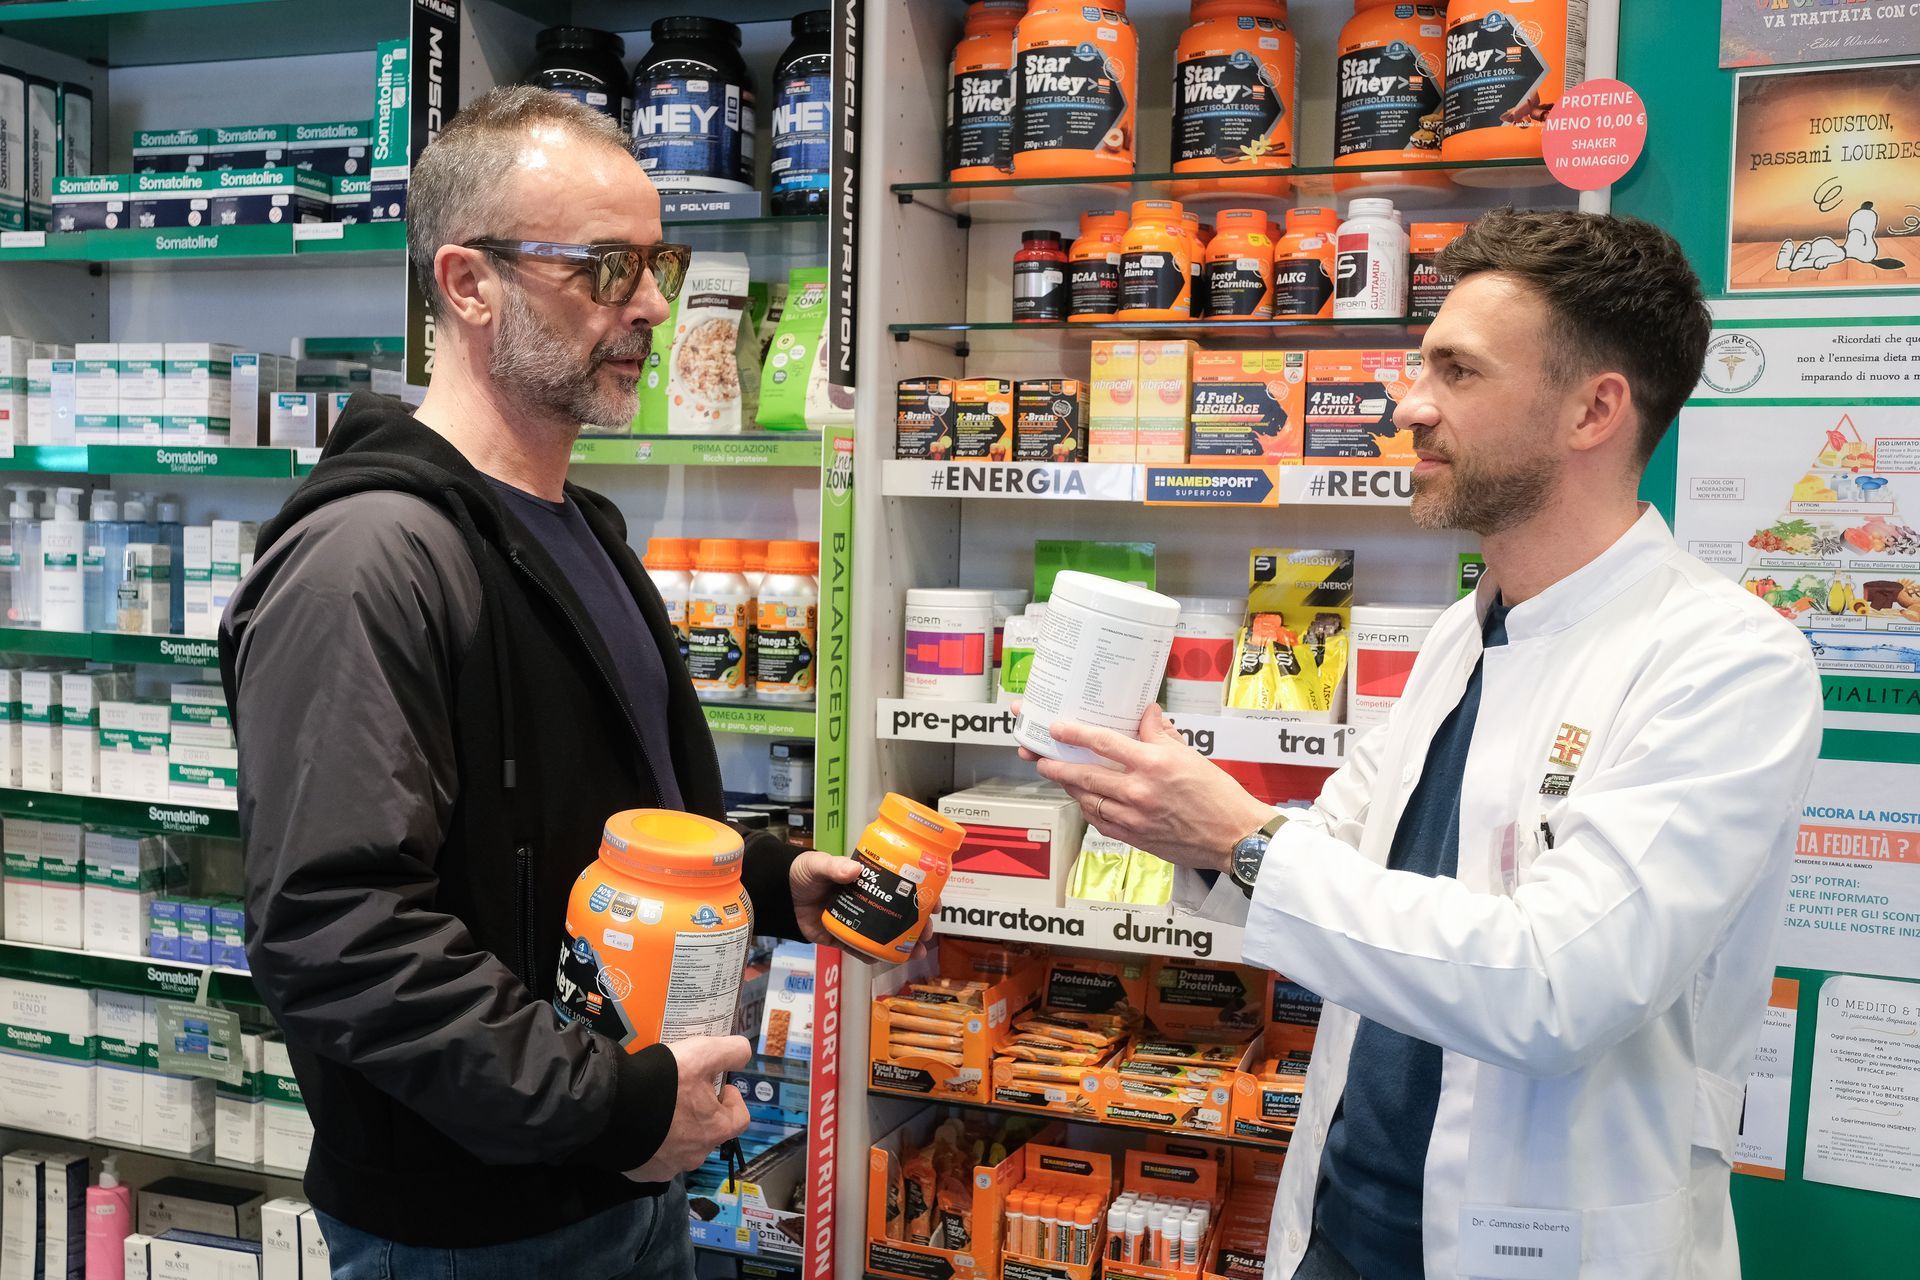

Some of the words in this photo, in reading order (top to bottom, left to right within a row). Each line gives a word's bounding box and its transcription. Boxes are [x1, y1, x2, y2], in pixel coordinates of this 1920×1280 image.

[1763, 15, 1786, 28] VA
[1791, 8, 1872, 26] TRATTATA
[1876, 4, 1905, 19] CON
[1447, 31, 1478, 57] Star
[1025, 54, 1071, 75] Star
[1341, 56, 1381, 80] Star
[1446, 49, 1495, 77] Whey
[1183, 65, 1226, 86] Star
[1493, 67, 1515, 76] 100%
[961, 77, 1003, 97] Star
[1025, 73, 1087, 96] Whey
[1342, 75, 1398, 98] Whey
[1184, 82, 1242, 104] Whey
[1396, 95, 1418, 103] 100%
[1561, 91, 1633, 109] PROTEINE
[374, 54, 395, 161] Somatoline
[962, 94, 1016, 116] Whey
[1240, 103, 1260, 111] 100%
[633, 103, 719, 136] WHEY
[1546, 114, 1591, 132] MENO
[1595, 113, 1633, 130] 10,00
[1635, 112, 1645, 126] €
[1809, 113, 1894, 136] HOUSTON,
[140, 131, 199, 147] Somatoline
[216, 127, 278, 143] Somatoline
[296, 125, 359, 140] Somatoline
[1571, 137, 1617, 150] SHAKER
[1555, 155, 1568, 168] IN
[1572, 153, 1630, 168] OMAGGIO
[1750, 145, 1831, 171] passami
[59, 178, 120, 194] Somatoline
[138, 175, 203, 191] Somatoline
[219, 171, 284, 187] Somatoline
[664, 202, 676, 213] IN
[681, 201, 731, 212] POLVERE
[155, 233, 219, 251] Somatoline
[838, 167, 857, 372] NUTRITION
[1124, 261, 1140, 270] Beta
[1124, 268, 1154, 278] Alanine
[1211, 271, 1237, 282] Acetyl
[1276, 272, 1307, 285] AAKG
[1413, 274, 1439, 285] PRO
[692, 278, 733, 293] MUESLI
[1100, 280, 1118, 289] PRO
[1211, 279, 1260, 290] L-Carnitine
[1370, 259, 1380, 310] GLUTAMIN
[793, 294, 822, 307] ZONA
[1731, 335, 1745, 345] Re
[1884, 333, 1902, 344] che
[1797, 355, 1816, 363] non
[1819, 353, 1825, 363] è
[1883, 352, 1908, 363] dieta
[1801, 371, 1853, 382] imparando
[1856, 371, 1867, 381] di
[1869, 373, 1901, 381] nuovo
[1903, 373, 1910, 381] a
[1196, 391, 1207, 402] 4
[1208, 391, 1237, 404] Fuel
[1310, 392, 1321, 403] 4
[1322, 391, 1355, 405] Fuel
[1195, 404, 1260, 414] RECHARGE
[1309, 405, 1355, 415] ACTIVE
[692, 444, 722, 454] PRIMA
[724, 444, 779, 454] COLAZIONE
[156, 449, 218, 466] Somatoline
[703, 454, 724, 463] Ricchi
[930, 466, 1086, 495] #ENERGIA
[1167, 475, 1254, 489] NAMEDSPORT
[1175, 489, 1232, 498] SUPERFOOD
[1318, 581, 1352, 591] ENERGY
[716, 633, 725, 646] 3
[758, 635, 787, 648] Omega
[787, 635, 795, 648] 3
[828, 531, 846, 743] BALANCED
[1357, 633, 1410, 644] SYFORM
[709, 710, 744, 721] OMEGA
[746, 712, 753, 721] 3
[753, 712, 766, 722] RX
[749, 722, 768, 733] ogni
[768, 723, 795, 734] giorno
[1278, 728, 1326, 755] tra
[826, 755, 841, 833] LIFE
[149, 807, 210, 825] Somatoline
[943, 805, 990, 818] SYFORM
[1859, 809, 1876, 822] LA
[1823, 832, 1890, 859] FEDELTÀ
[1897, 838, 1910, 859] ?
[1815, 876, 1860, 889] POTRAI:
[1819, 890, 1889, 906] INFORMATO
[1799, 904, 1834, 916] PUNTI
[1836, 907, 1858, 918] PER
[1861, 909, 1879, 919] GLI
[940, 903, 1085, 937] maratona
[1113, 913, 1214, 957] during
[1814, 919, 1847, 932] SULLE
[1850, 923, 1895, 936] NOSTRE
[1052, 973, 1113, 988] Proteinbar
[1178, 971, 1215, 981] Dream
[1178, 980, 1237, 995] Proteinbar
[1826, 996, 1840, 1008] IO
[1845, 999, 1898, 1014] MEDITO
[1902, 1006, 1910, 1016] &
[821, 963, 839, 1077] SPORT
[7, 1026, 52, 1045] Somatoline
[101, 1041, 138, 1056] Somatoline
[1759, 1046, 1778, 1055] 18.30
[1756, 1070, 1774, 1080] 18.30
[1857, 1066, 1885, 1075] EFFICACE
[996, 1088, 1029, 1099] Proteinbar
[1881, 1084, 1905, 1092] SALUTE
[1884, 1092, 1920, 1102] BENESSERE
[1112, 1107, 1170, 1122] DreamProteinbar
[1740, 1141, 1762, 1152] Puppo
[814, 1088, 836, 1279] NUTRITION
[746, 1219, 762, 1230] THE
[1472, 1217, 1487, 1227] Dr.
[1532, 1221, 1570, 1233] Roberto
[1225, 1254, 1254, 1266] Total
